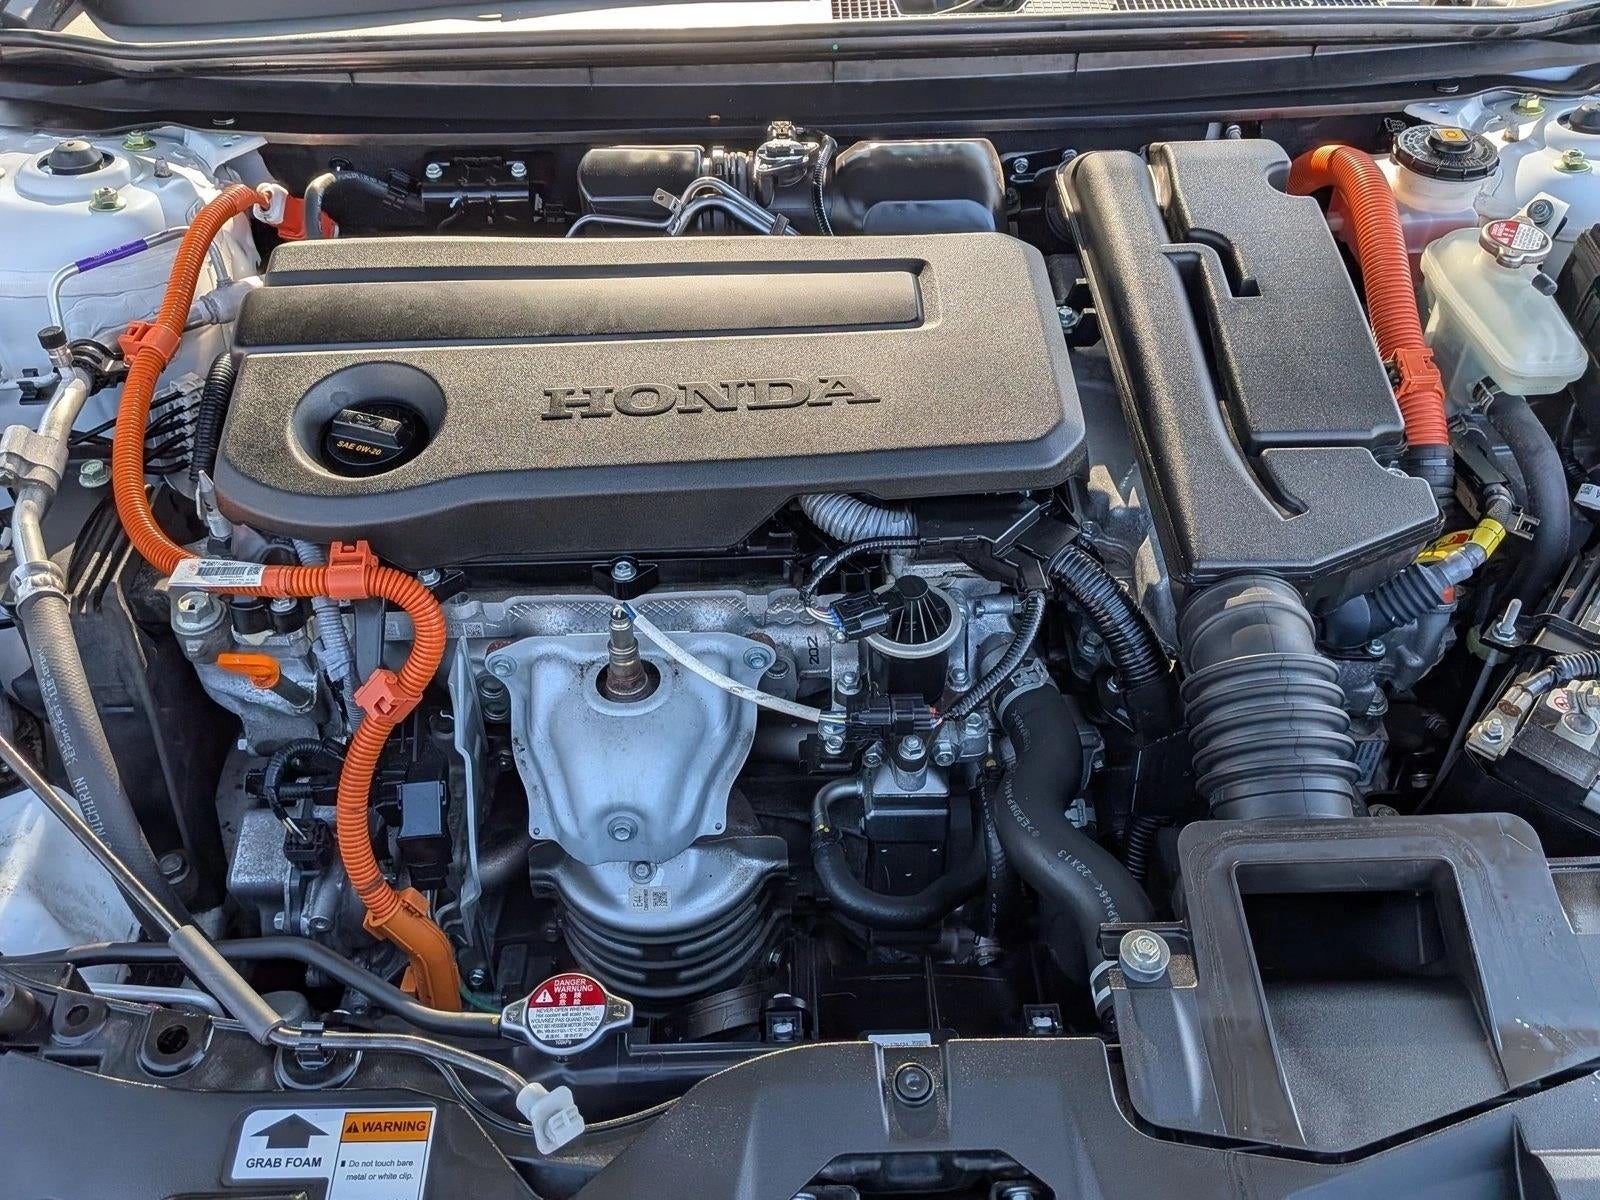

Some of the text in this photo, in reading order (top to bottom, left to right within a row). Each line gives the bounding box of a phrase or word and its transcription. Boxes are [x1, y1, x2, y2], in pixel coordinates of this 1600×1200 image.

[541, 375, 881, 420] HONDA
[337, 440, 382, 456] SAE 0W-20
[807, 635, 819, 665] 202
[73, 776, 107, 838] NICHIRIN
[554, 979, 586, 987] DANGER
[554, 984, 594, 993] WARNUNG
[362, 1121, 426, 1133] WARNING
[246, 1157, 322, 1168] GRAB FOAM
[375, 1159, 395, 1167] touch
[397, 1159, 413, 1167] bare
[378, 1172, 397, 1180] white
[399, 1172, 414, 1181] clip.
